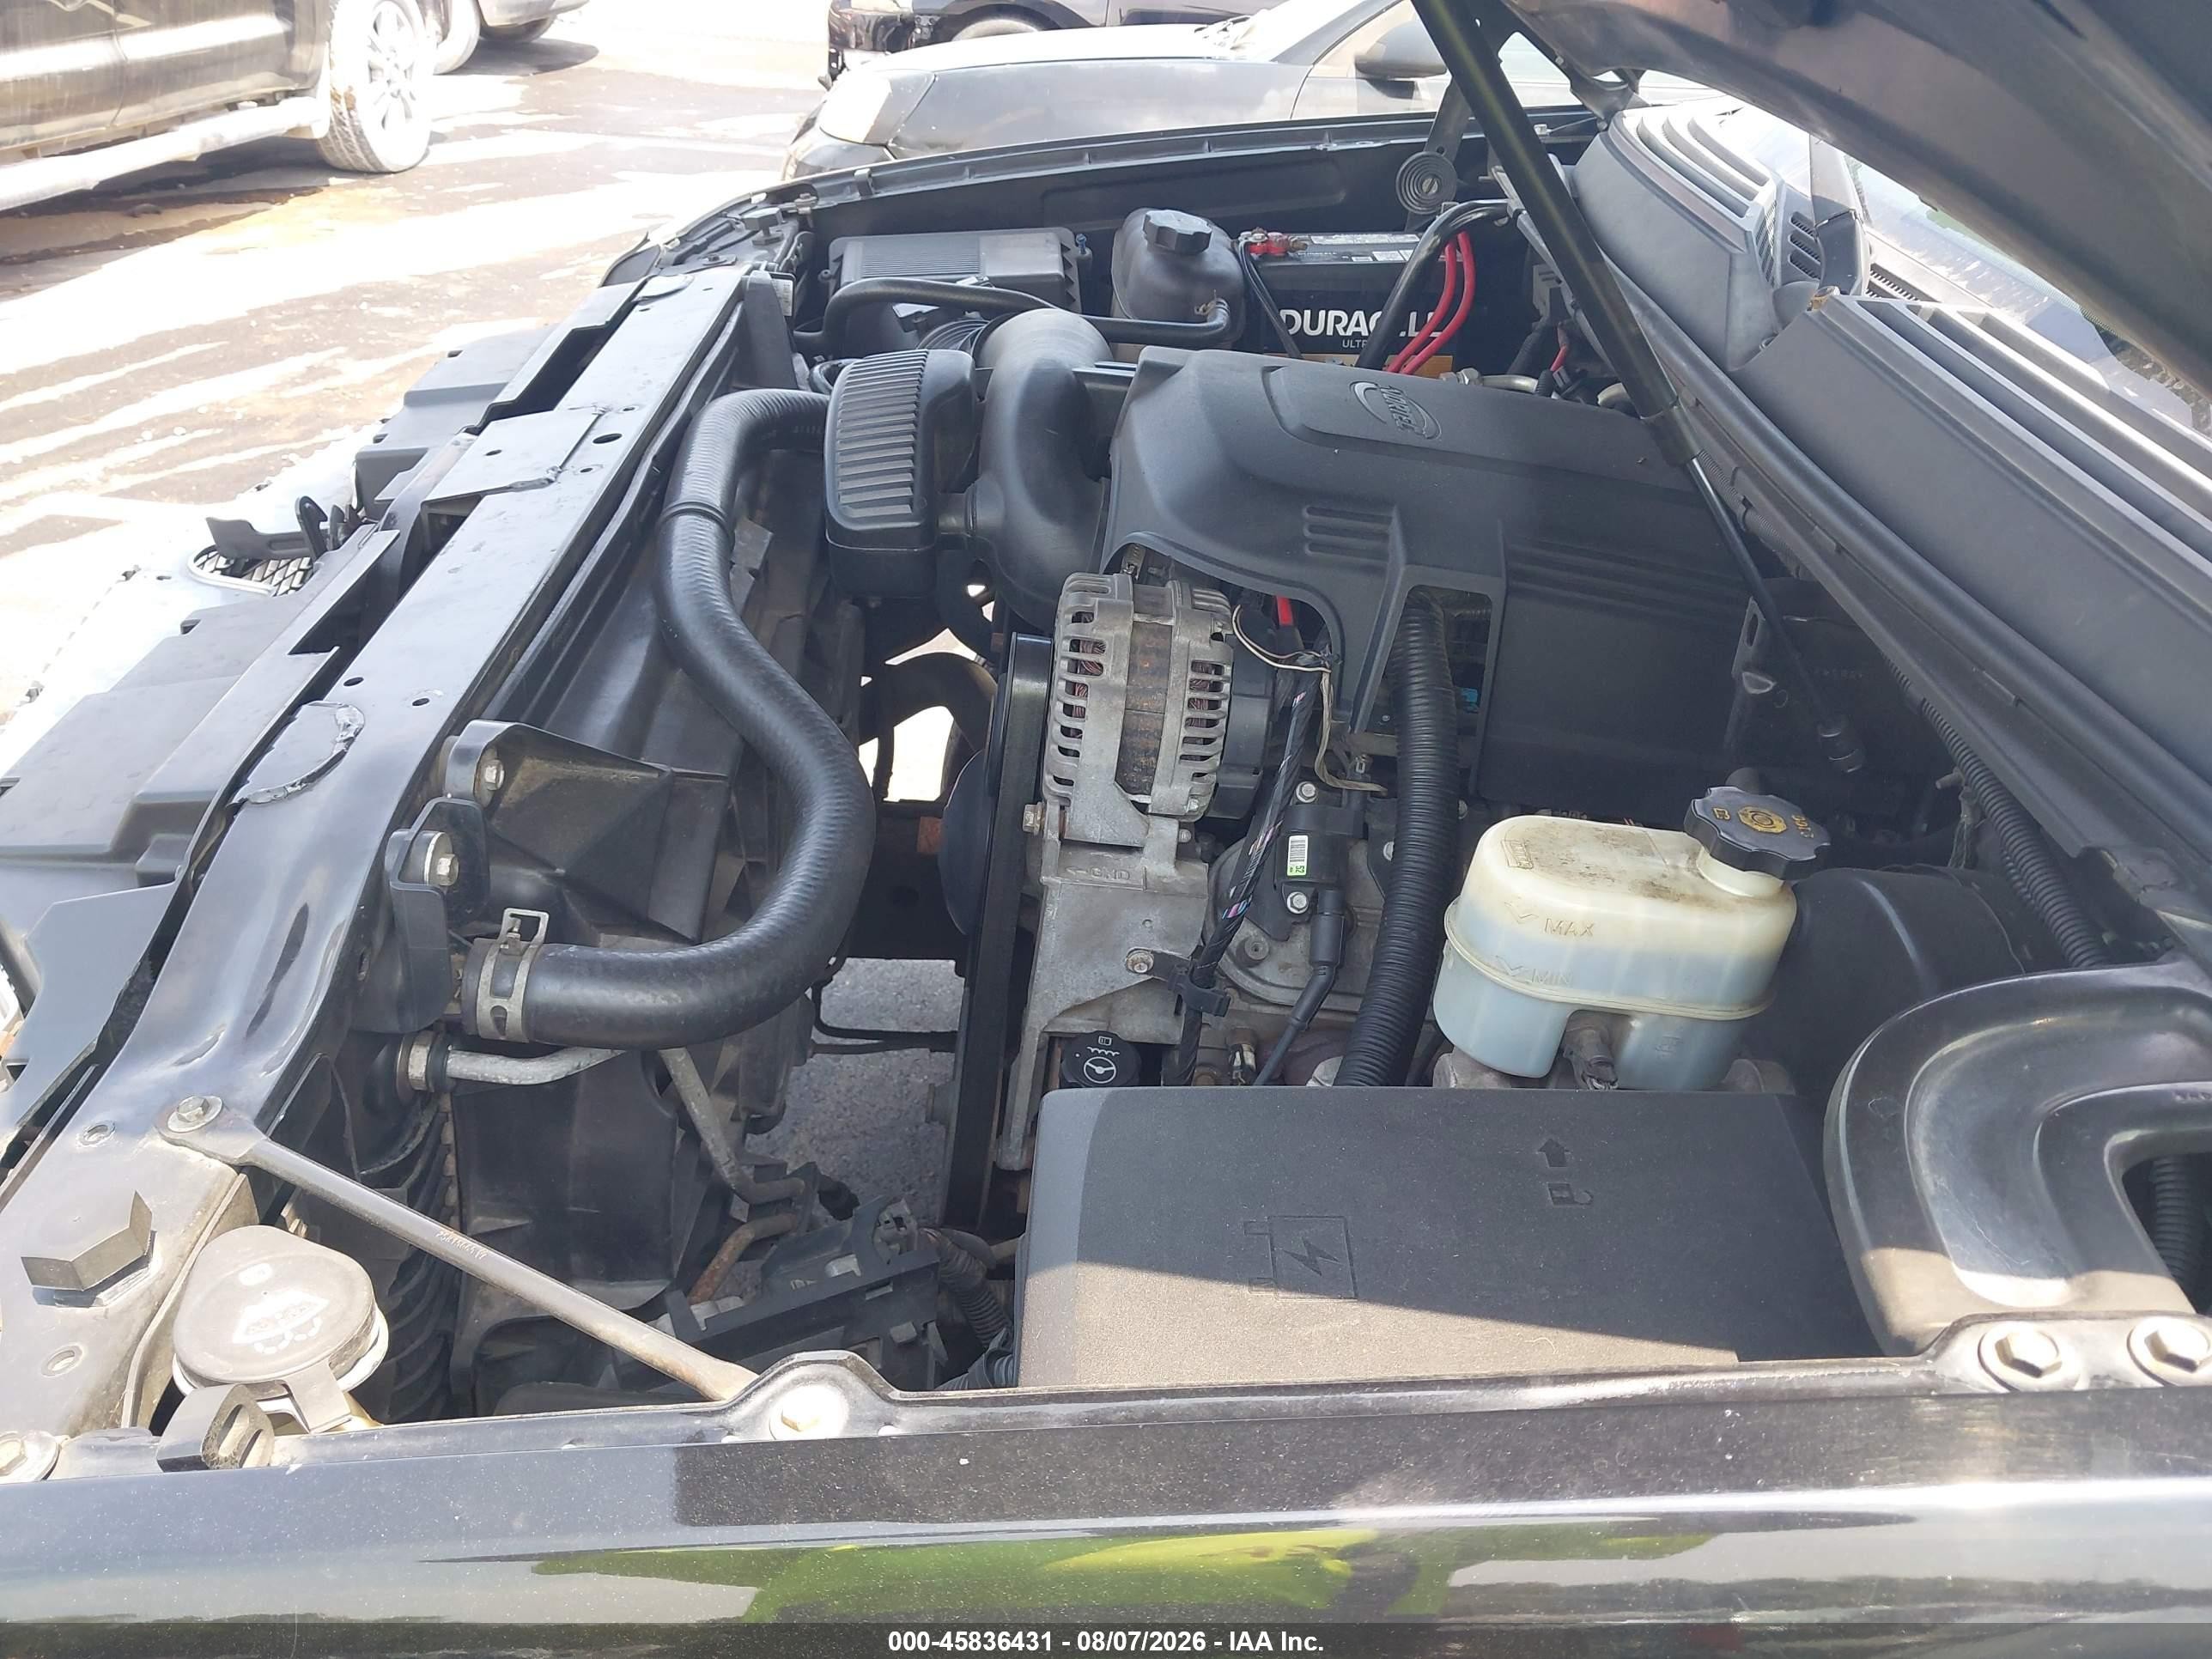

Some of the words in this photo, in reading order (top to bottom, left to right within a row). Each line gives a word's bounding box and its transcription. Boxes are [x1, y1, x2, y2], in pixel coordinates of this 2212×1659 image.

[1279, 309, 1443, 337] DURALL
[1342, 339, 1368, 349] ULTR
[1545, 918, 1595, 936] MAX
[1531, 968, 1572, 988] MIN
